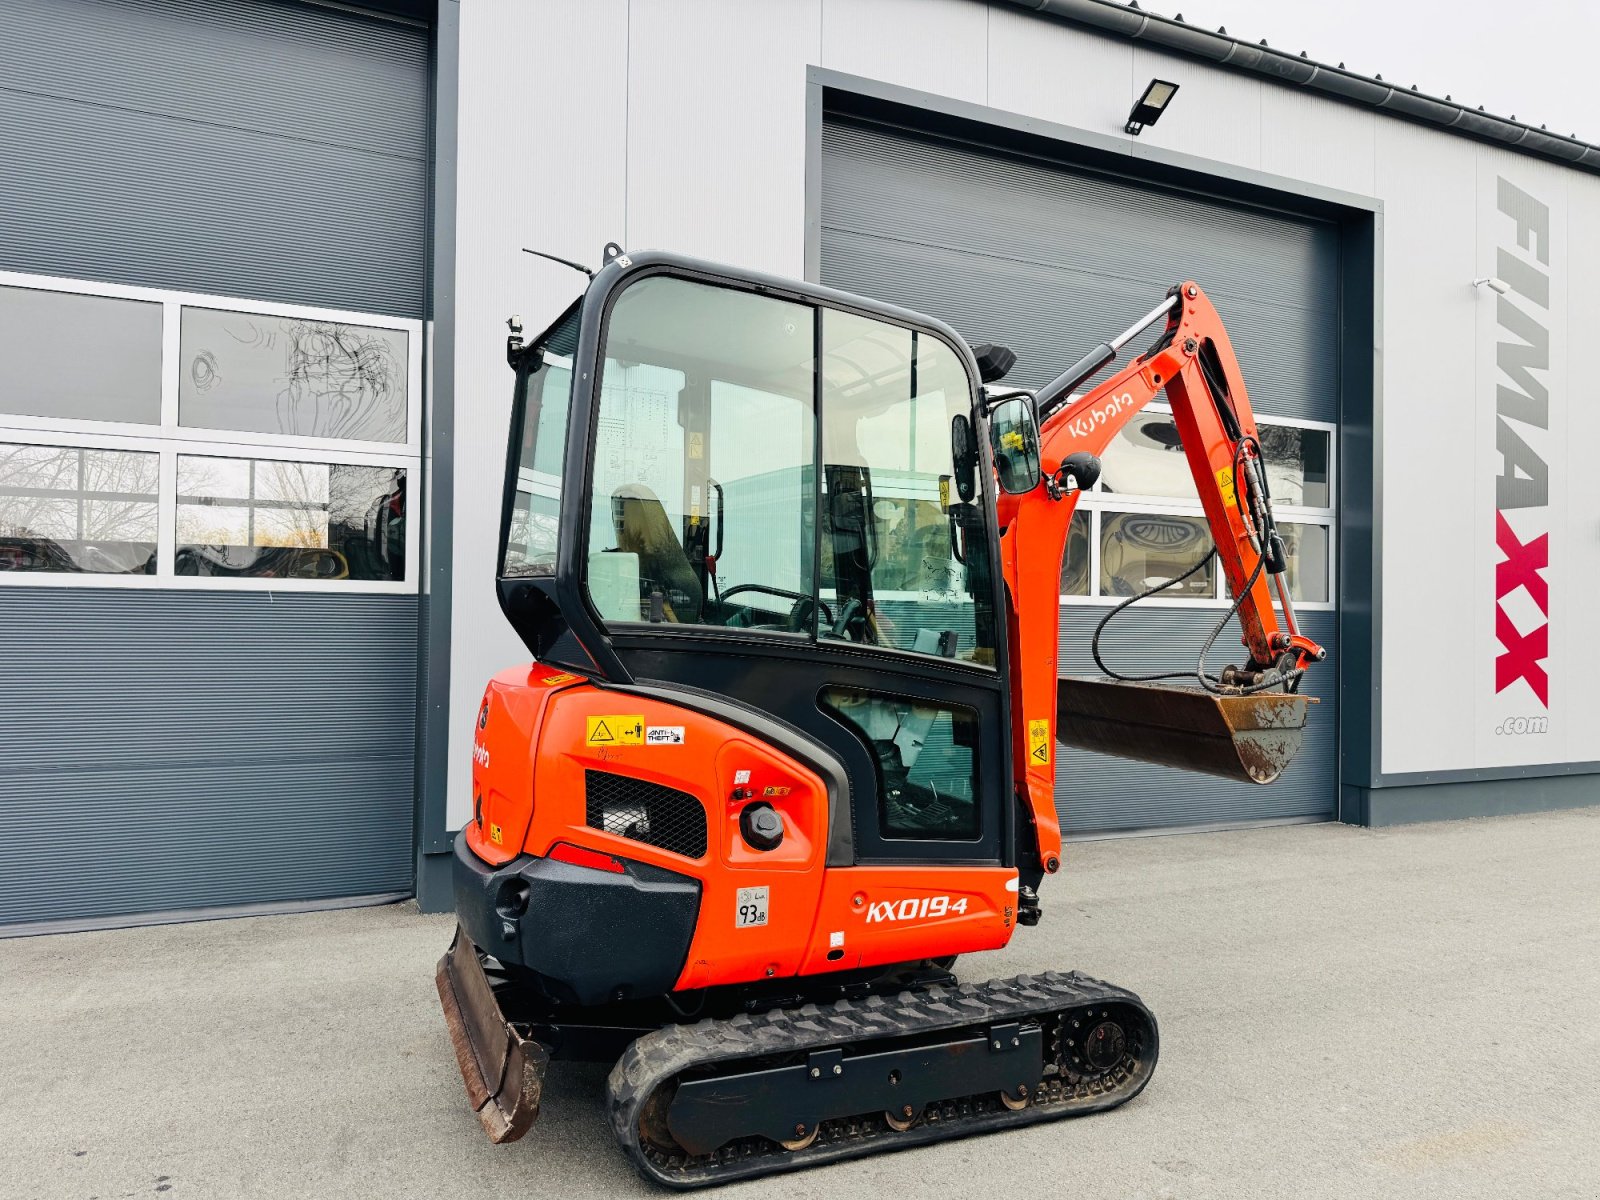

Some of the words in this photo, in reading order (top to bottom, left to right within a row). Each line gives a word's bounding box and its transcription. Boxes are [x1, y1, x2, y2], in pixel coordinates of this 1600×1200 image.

[1068, 393, 1134, 438] Kubota
[1496, 175, 1549, 709] FIMAXX
[1495, 716, 1549, 735] .com
[739, 904, 758, 924] 93
[866, 896, 968, 924] KX019-4
